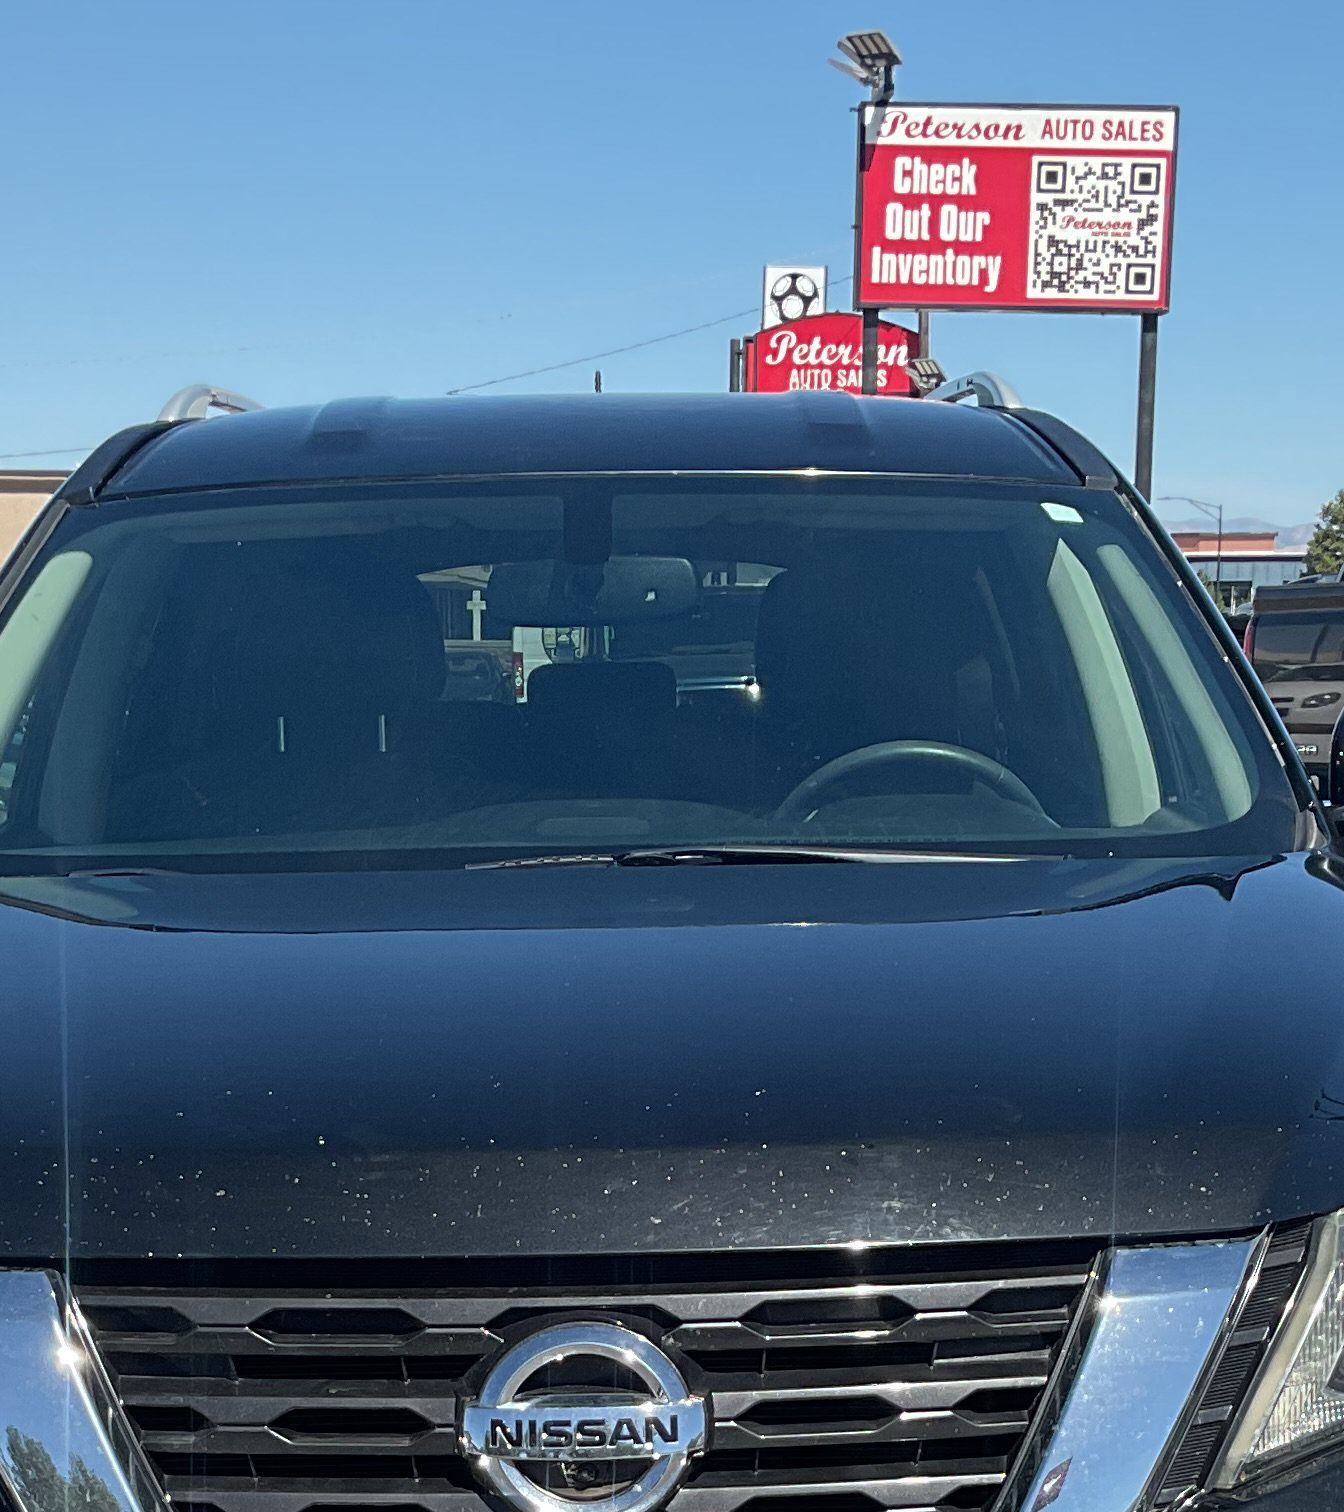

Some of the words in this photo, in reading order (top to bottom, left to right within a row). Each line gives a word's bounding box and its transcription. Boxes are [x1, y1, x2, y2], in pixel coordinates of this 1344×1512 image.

[877, 110, 1026, 141] Peterson
[1041, 118, 1094, 141] AUTO
[1101, 119, 1165, 142] SALES
[893, 155, 977, 196] Check
[885, 202, 931, 241] Out
[939, 203, 991, 242] Our
[1059, 214, 1133, 230] Peterson
[870, 246, 1002, 293] Inventory
[789, 368, 832, 386] AUTO
[489, 1414, 679, 1449] NISSAN
